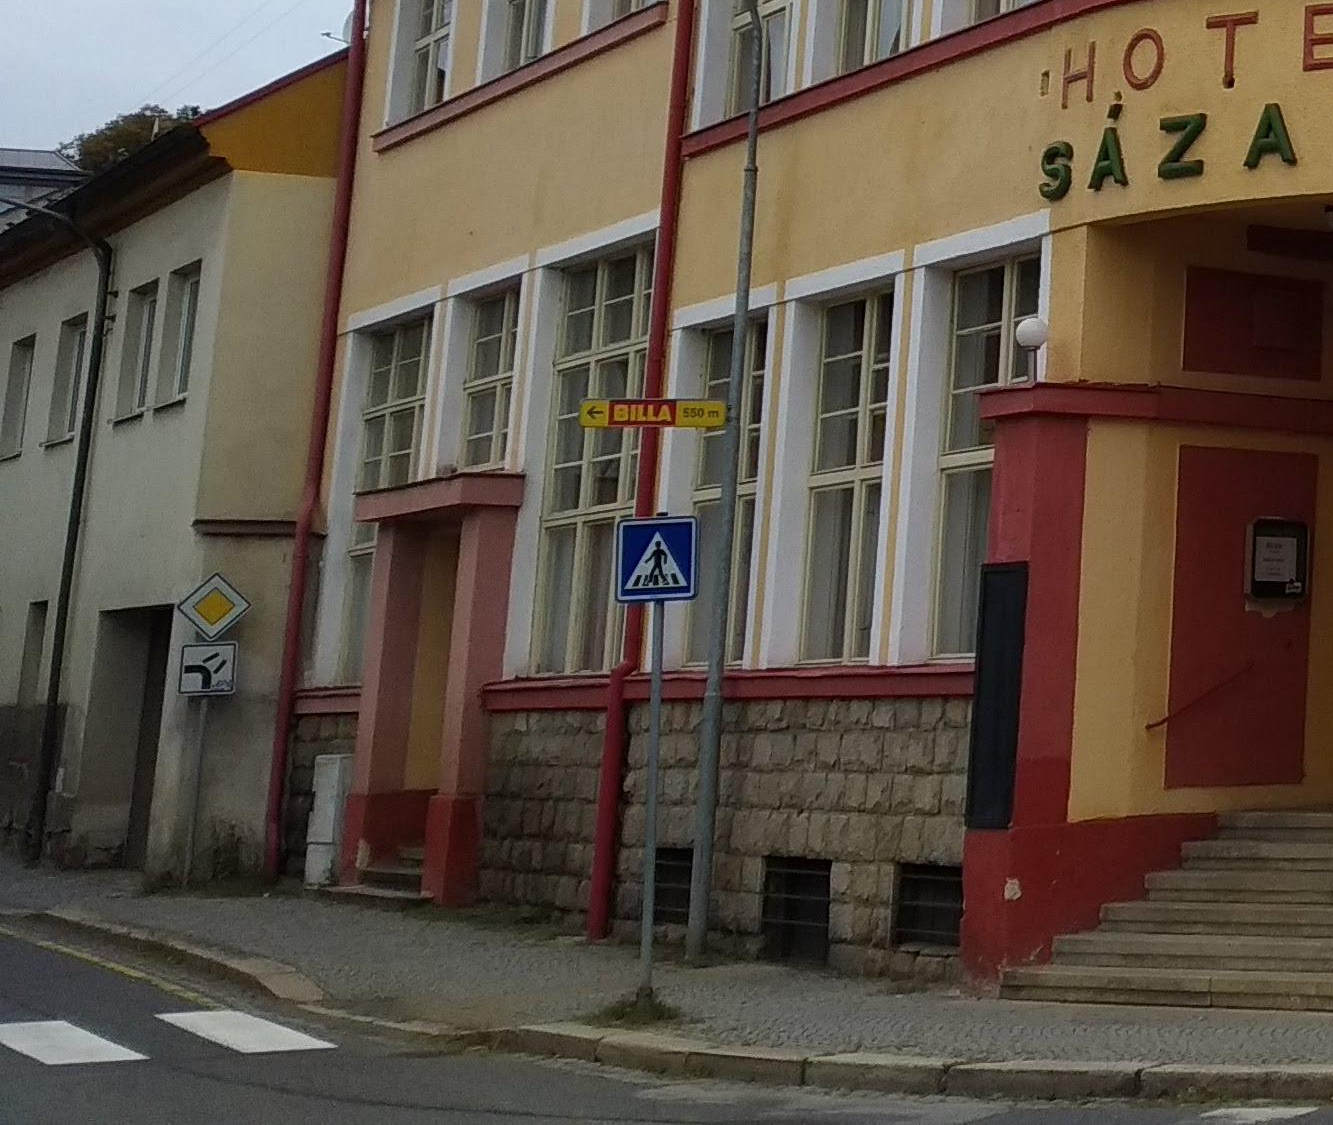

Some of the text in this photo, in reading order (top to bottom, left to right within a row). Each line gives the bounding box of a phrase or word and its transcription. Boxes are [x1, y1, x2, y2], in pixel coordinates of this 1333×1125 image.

[613, 404, 719, 422] BILLA 550 m
